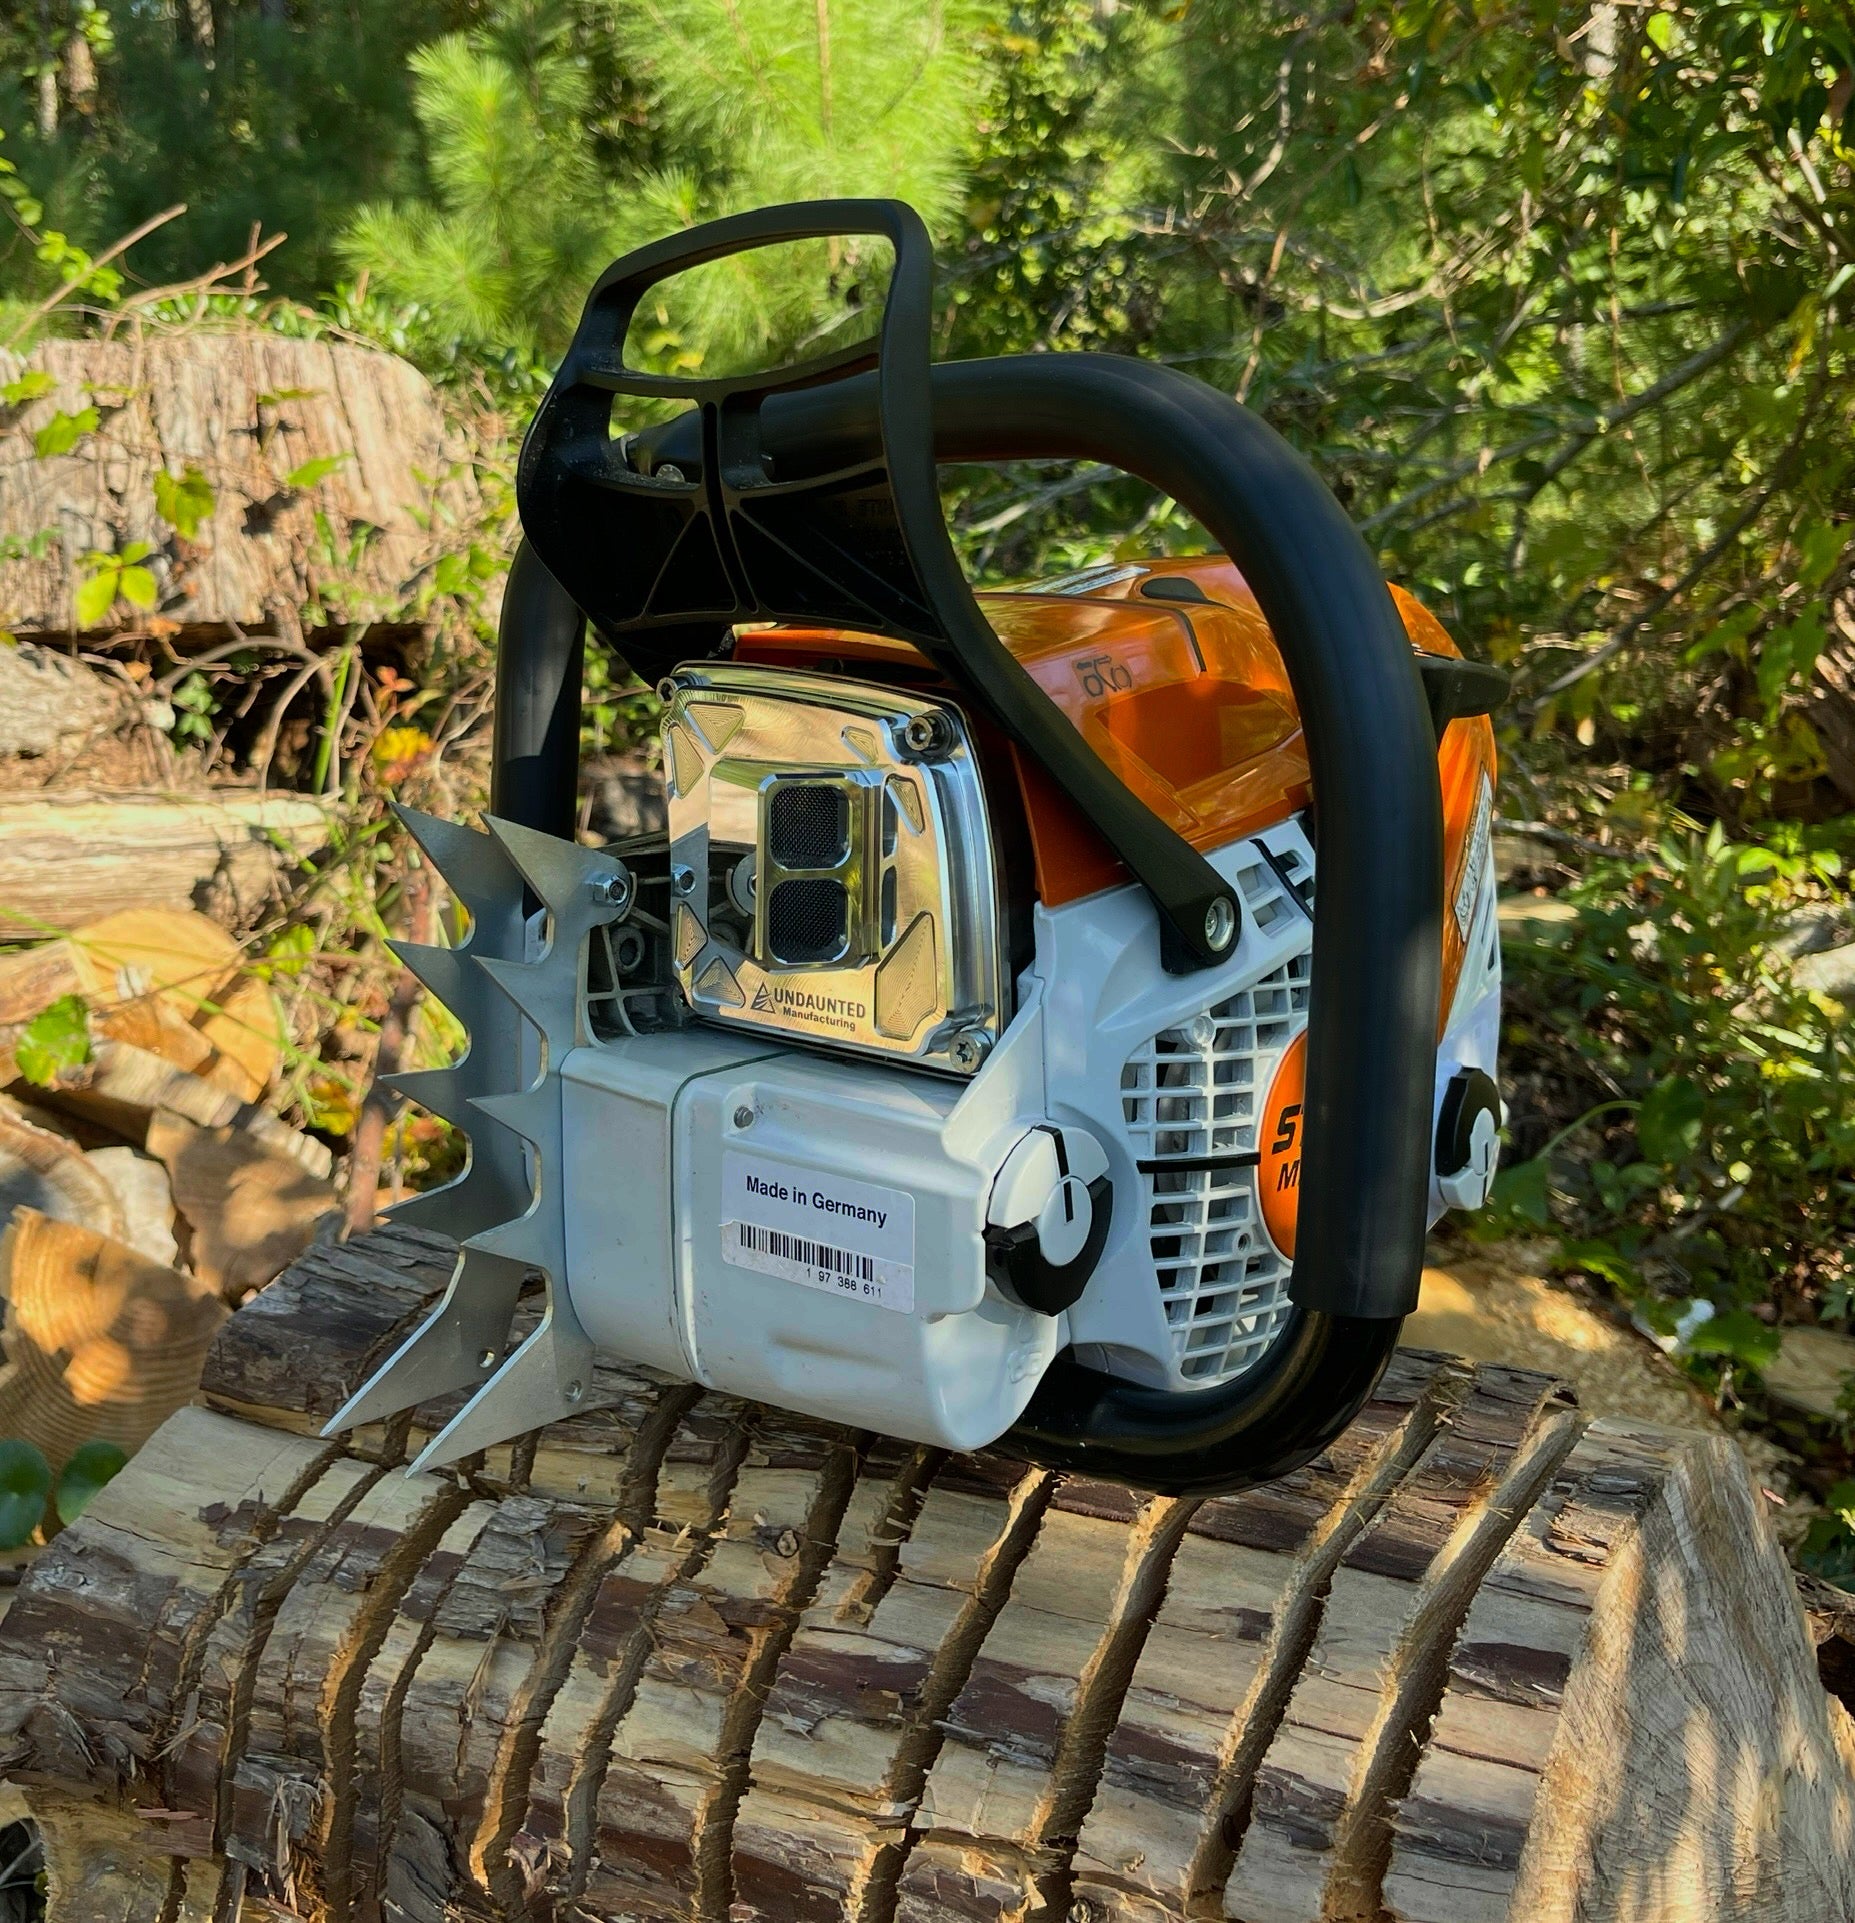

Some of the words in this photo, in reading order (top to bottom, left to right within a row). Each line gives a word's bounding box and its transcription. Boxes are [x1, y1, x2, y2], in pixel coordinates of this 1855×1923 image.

[774, 987, 866, 1019] UNDAUNTED
[783, 1006, 856, 1032] Manufacturing
[1271, 1103, 1304, 1156] S
[746, 1175, 788, 1201] Made
[793, 1187, 807, 1206] in
[812, 1192, 888, 1229] Germany
[806, 1267, 812, 1279] 1
[818, 1270, 831, 1283] 97
[837, 1276, 857, 1291] 388
[863, 1283, 882, 1298] 611
